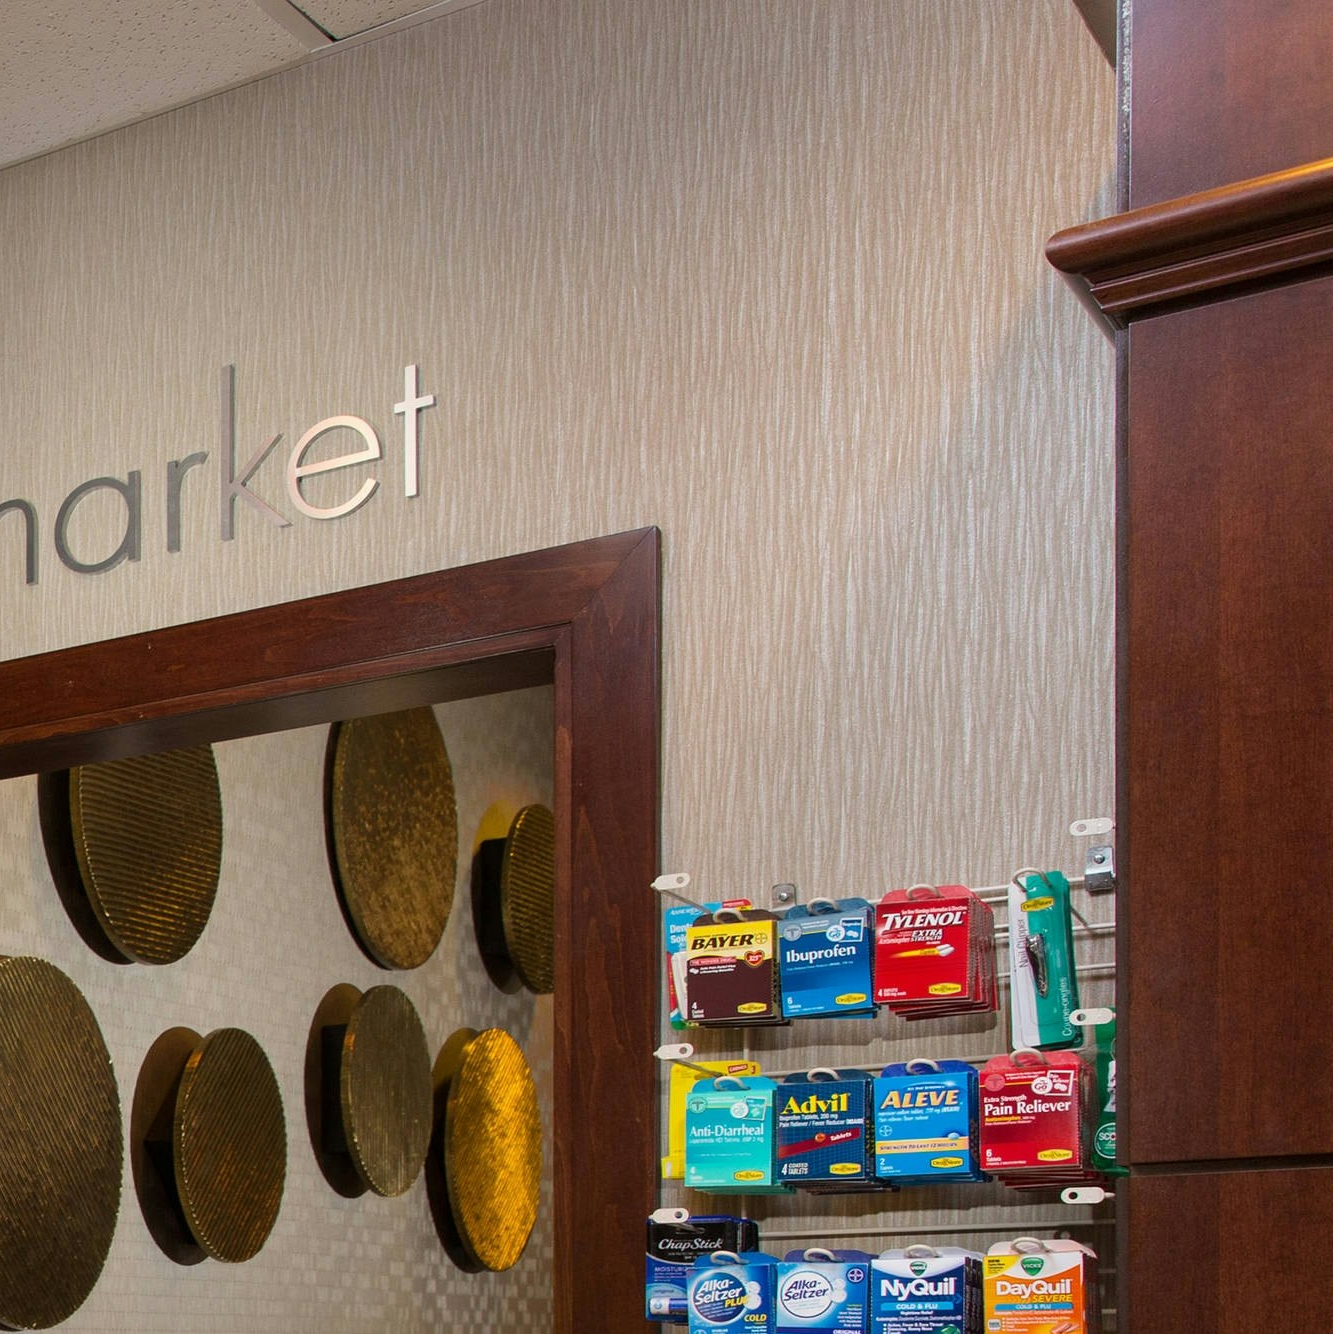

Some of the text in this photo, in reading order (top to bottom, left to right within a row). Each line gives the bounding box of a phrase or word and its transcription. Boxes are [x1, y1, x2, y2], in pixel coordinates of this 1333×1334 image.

[880, 911, 964, 932] TYLENOL
[911, 929, 942, 938] EXTRA
[911, 935, 942, 943] STRENGTH
[691, 932, 754, 951] BAYER
[786, 943, 856, 964] Ibuprofen
[878, 989, 883, 997] 4
[692, 1002, 697, 1010] 4
[781, 1093, 848, 1115] Advil
[880, 1090, 959, 1109] ALEVE
[1000, 1094, 1027, 1103] Strength
[984, 1100, 1072, 1117] Pain Reliever
[690, 1123, 764, 1138] Anti-Diarrheal
[830, 1131, 852, 1142] Tablets
[986, 1149, 992, 1157] 6
[781, 1163, 788, 1176] 4
[658, 1238, 724, 1251] ChapStick
[699, 1279, 733, 1293] Alka-
[787, 1280, 821, 1291] Alka-
[880, 1278, 954, 1301] NyQuil
[996, 1279, 1072, 1299] DayQuil
[694, 1287, 743, 1305] Seltzer
[783, 1287, 829, 1302] Seltzer
[1033, 1294, 1073, 1302] SEVERE
[743, 1314, 767, 1322] COLD
